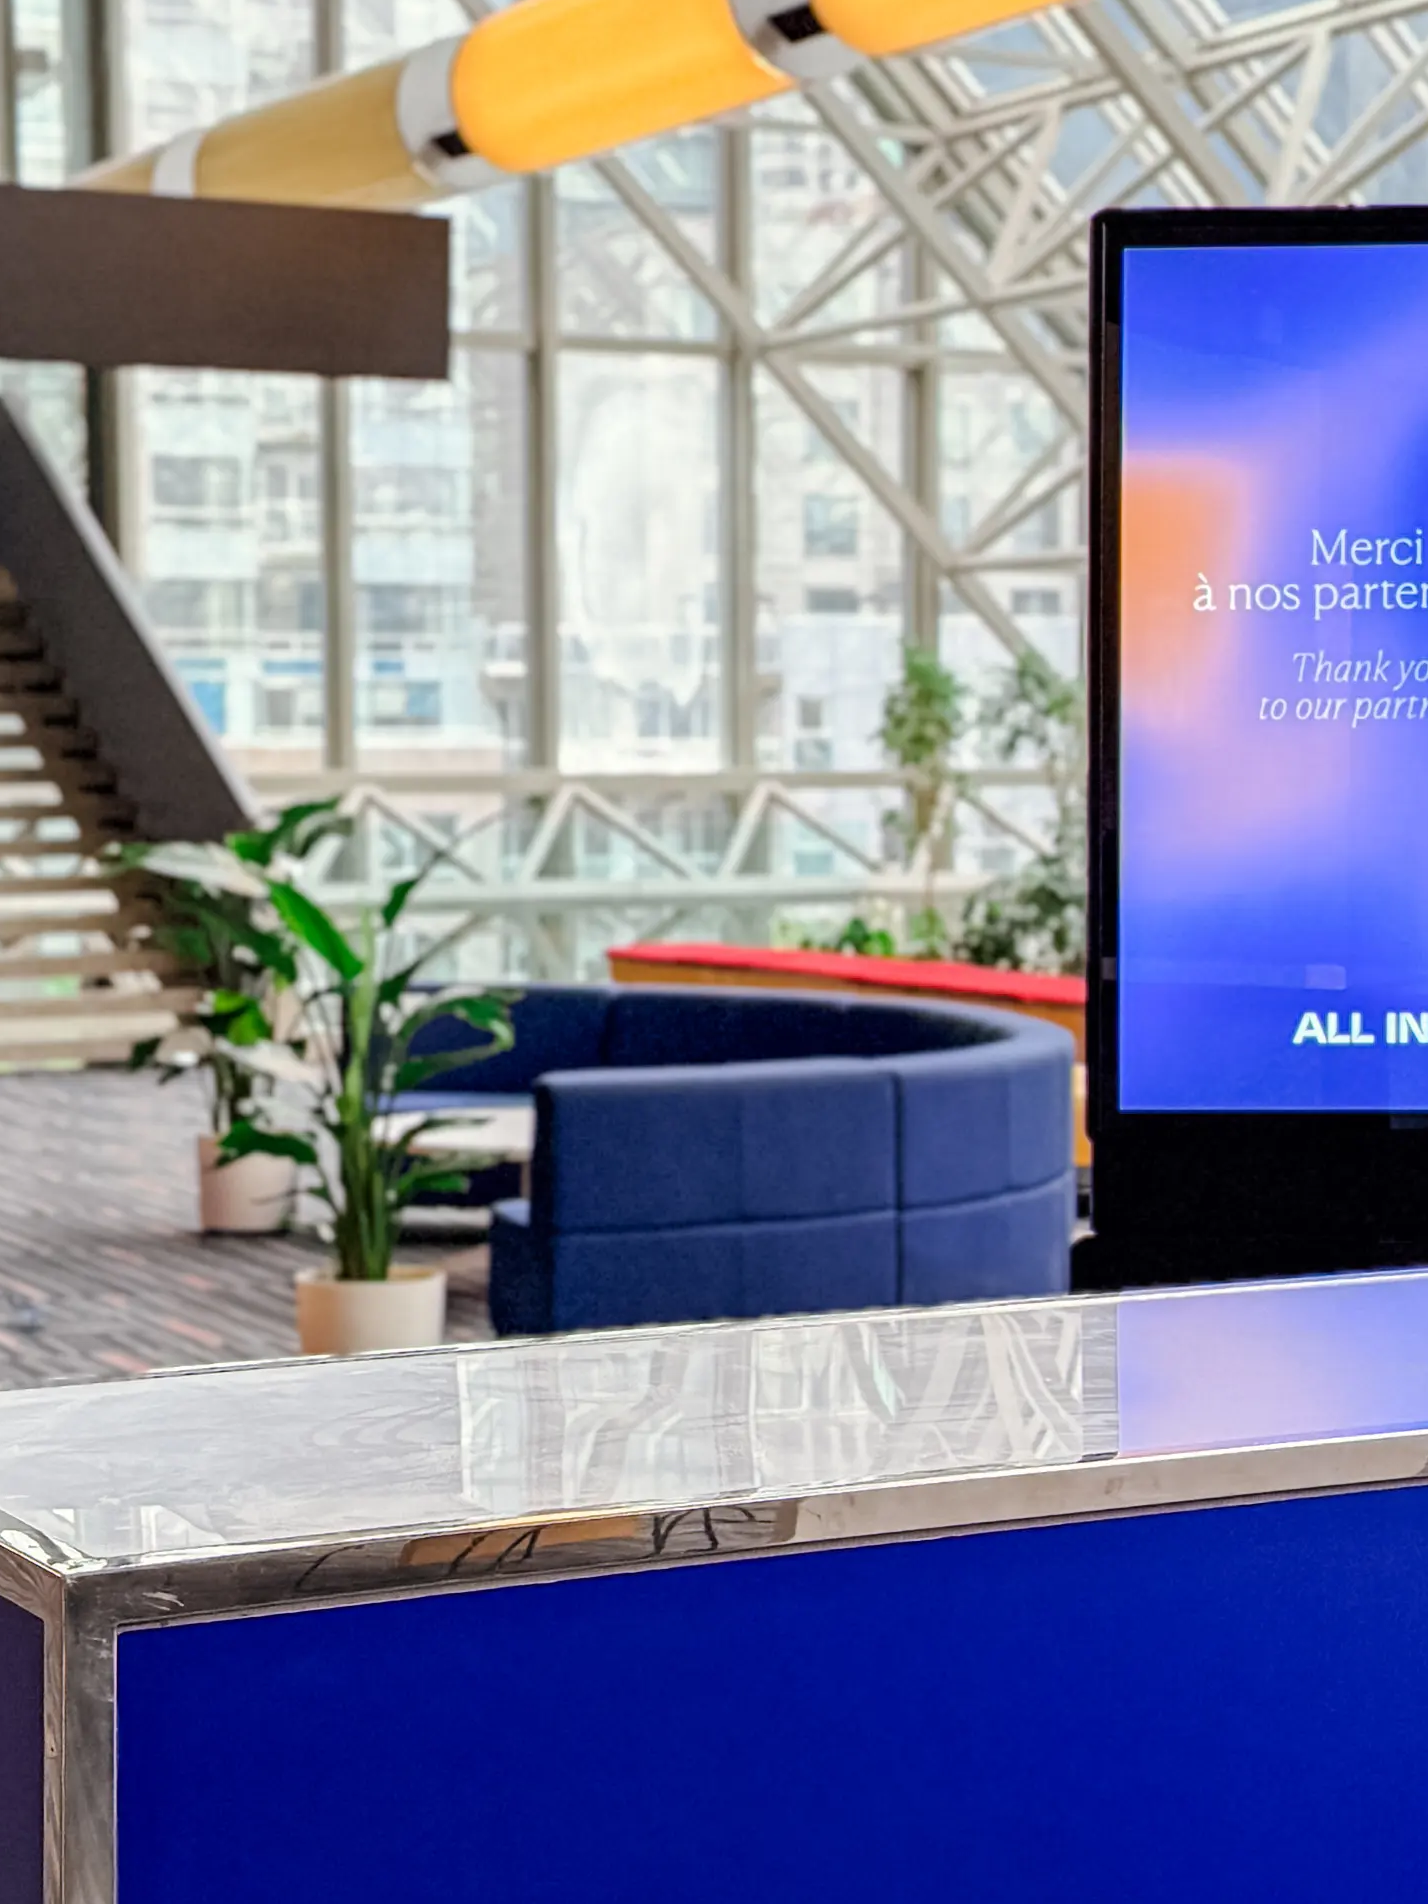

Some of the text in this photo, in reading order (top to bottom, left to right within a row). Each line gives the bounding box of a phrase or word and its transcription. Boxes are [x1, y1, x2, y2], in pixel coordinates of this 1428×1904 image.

[1310, 527, 1424, 567] Merci
[1192, 572, 1217, 612] à
[1227, 578, 1300, 612] nos
[1292, 649, 1389, 684] Thank
[1258, 695, 1288, 721] to
[1295, 697, 1345, 721] our
[1292, 1011, 1375, 1045] ALL
